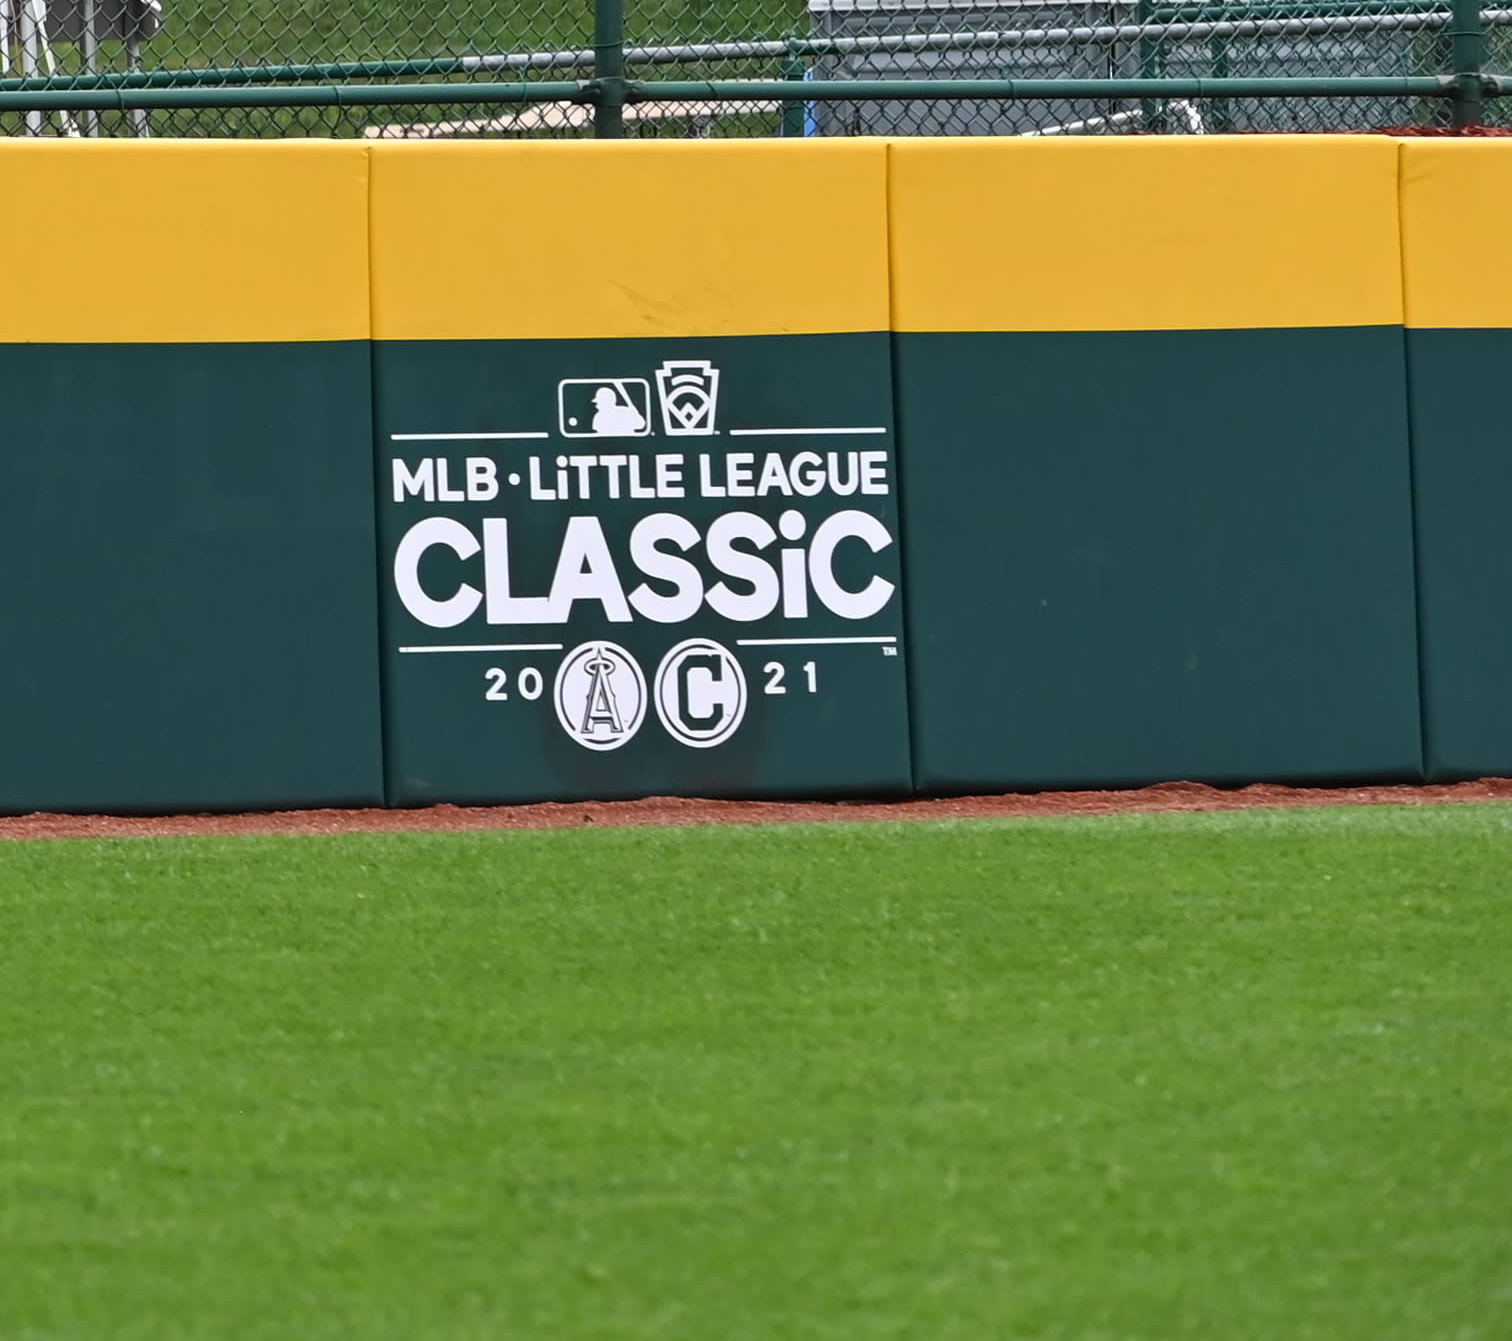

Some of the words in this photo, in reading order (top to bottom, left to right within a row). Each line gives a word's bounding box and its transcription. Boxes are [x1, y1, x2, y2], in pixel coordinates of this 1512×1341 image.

[393, 458, 498, 502] MLB
[700, 451, 888, 497] LEAGUE
[485, 668, 543, 700] 20
[677, 654, 724, 731] C
[764, 662, 816, 694] 21
